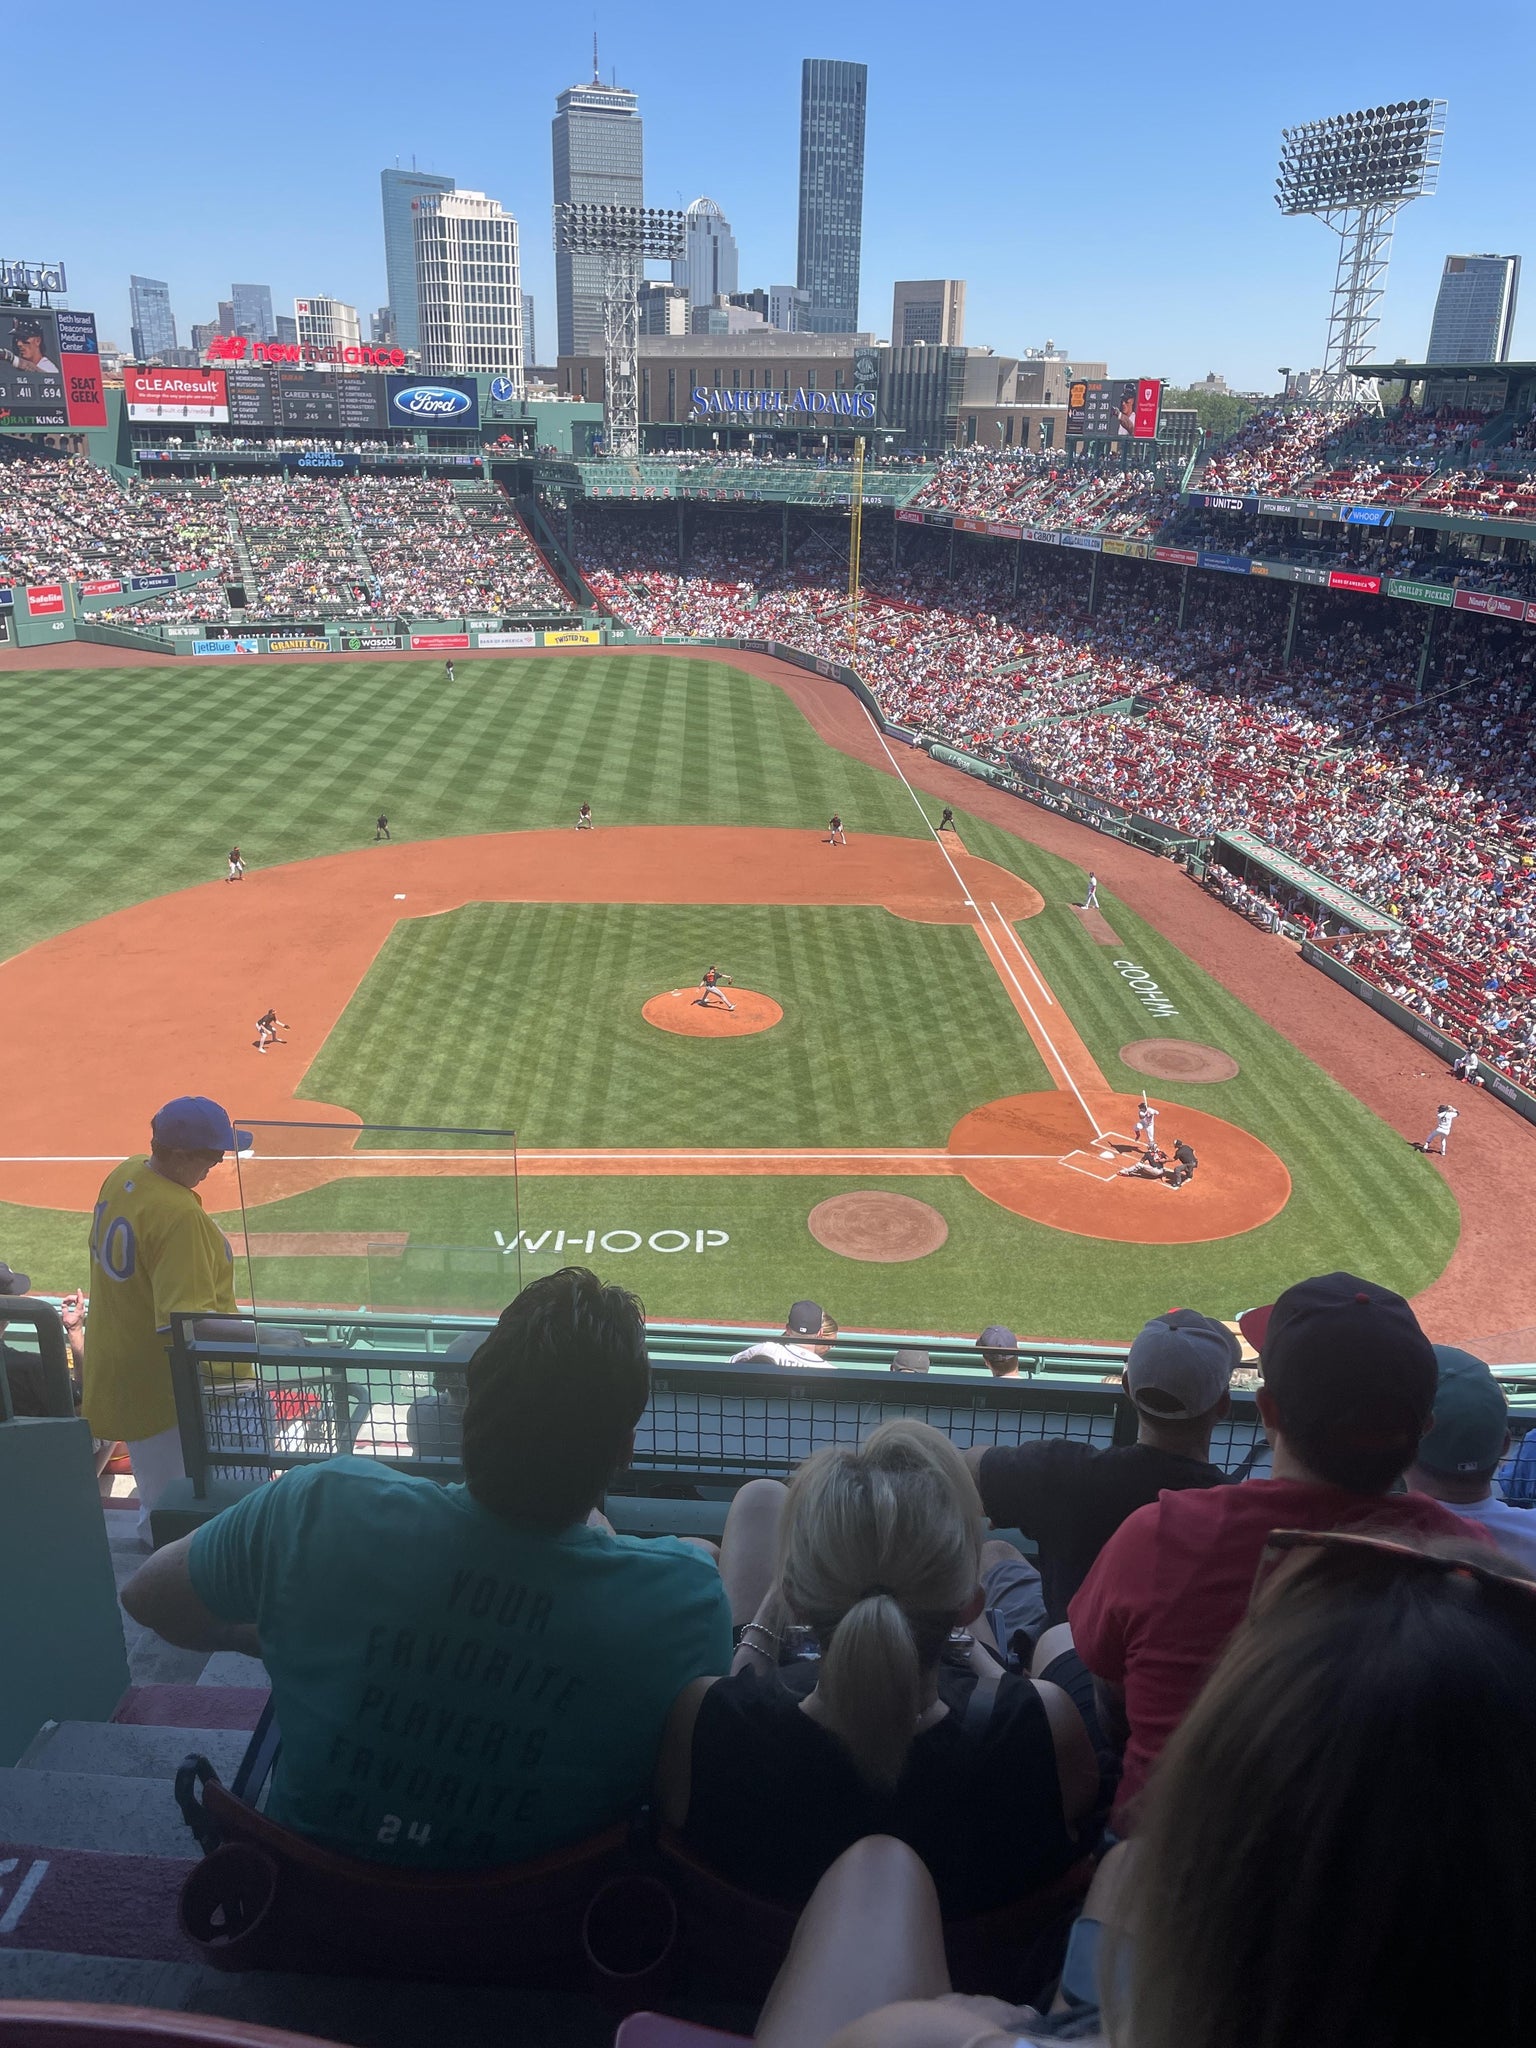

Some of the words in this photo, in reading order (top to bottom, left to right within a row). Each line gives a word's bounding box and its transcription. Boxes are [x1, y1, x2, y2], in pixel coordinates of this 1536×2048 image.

[59, 314, 73, 323] Beth
[75, 316, 91, 324] Israel
[60, 324, 93, 334] Deaconess
[61, 333, 85, 343] Medical
[62, 342, 83, 351] Center
[71, 377, 96, 390] SEAT
[135, 379, 217, 392] CLEAResult
[17, 388, 32, 398] .411
[41, 388, 61, 398] .694
[71, 391, 100, 404] GEEK
[284, 391, 309, 399] CAREER
[410, 391, 455, 412] Ford
[692, 386, 791, 416] SAMUEL
[792, 386, 876, 419] ADAMS
[304, 452, 337, 460] ANGRY
[297, 459, 344, 468] ORCHARD
[1212, 499, 1243, 510] UNITED
[1276, 505, 1291, 513] BREAK
[1352, 511, 1380, 521] WHOOP
[29, 594, 62, 604] Safelite
[52, 622, 65, 630] 420
[361, 637, 396, 647] wasabi
[554, 634, 579, 644] TWISTED
[579, 634, 589, 643] TEA
[198, 641, 231, 651] jetBlue
[270, 640, 308, 651] GRANITE
[309, 640, 329, 651] CITY
[1112, 960, 1180, 1018] WHOOP
[494, 1229, 730, 1255] WHOOP
[446, 1568, 554, 1636] YOUR
[364, 1624, 586, 1715] FAVORITE
[356, 1683, 548, 1770] PLAYER'S
[377, 1814, 432, 1846] 24
